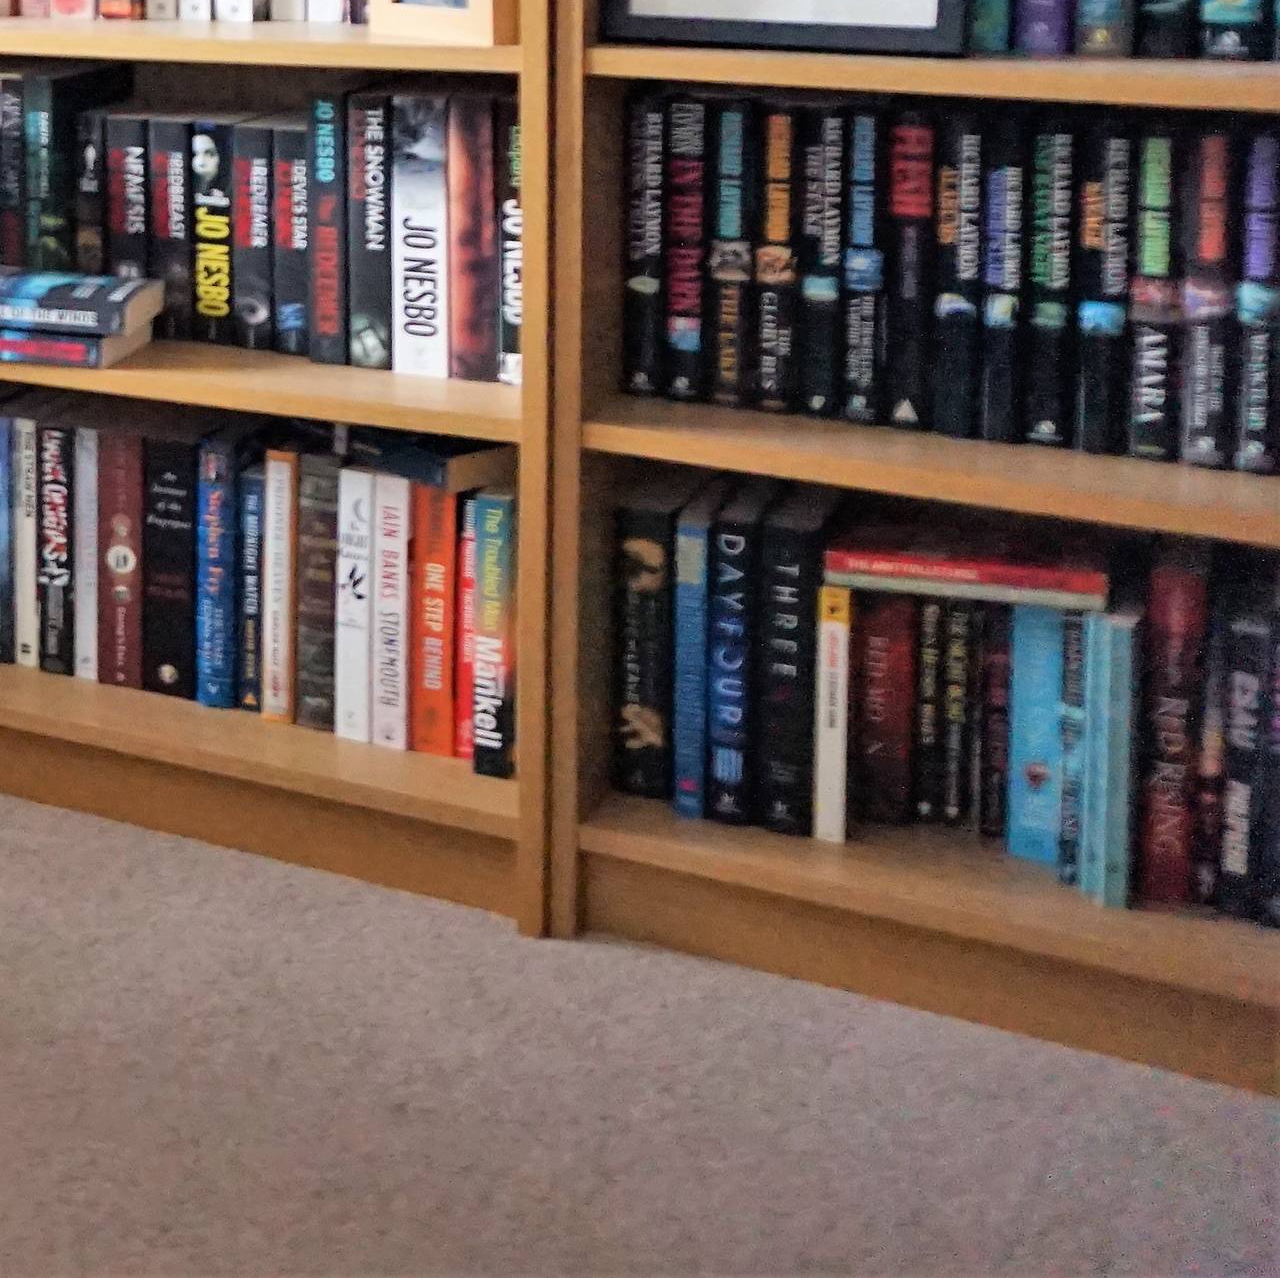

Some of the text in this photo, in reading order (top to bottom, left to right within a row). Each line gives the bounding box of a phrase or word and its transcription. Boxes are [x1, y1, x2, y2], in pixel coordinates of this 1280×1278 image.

[126, 147, 145, 233] NEMESIS
[317, 99, 335, 182] JO NESBO
[366, 109, 385, 250] THE SNOWMAN
[822, 117, 841, 266] RICHARD LAYMON
[169, 159, 185, 239] REDBREAST
[252, 166, 268, 248] REDEEMER
[294, 166, 306, 250] DEVIL'S STAR
[645, 189, 661, 255] LAYMON
[959, 134, 980, 280] RICHARD LAYMON
[1104, 138, 1128, 294] RICHARD LAYMON
[195, 207, 230, 317] JO NESBO
[403, 218, 437, 336] JO NESBO
[1140, 326, 1166, 422] AMARA
[204, 488, 223, 595] Stephen Fry
[244, 514, 259, 571] MIDNIGHT
[244, 575, 258, 614] WATCH
[380, 506, 399, 707] IAIN BANKS STONEMOUTH
[423, 563, 444, 691] ONE STEP BEHIND
[473, 508, 503, 748] The Troubled Man Mankell
[771, 564, 799, 678] THREE
